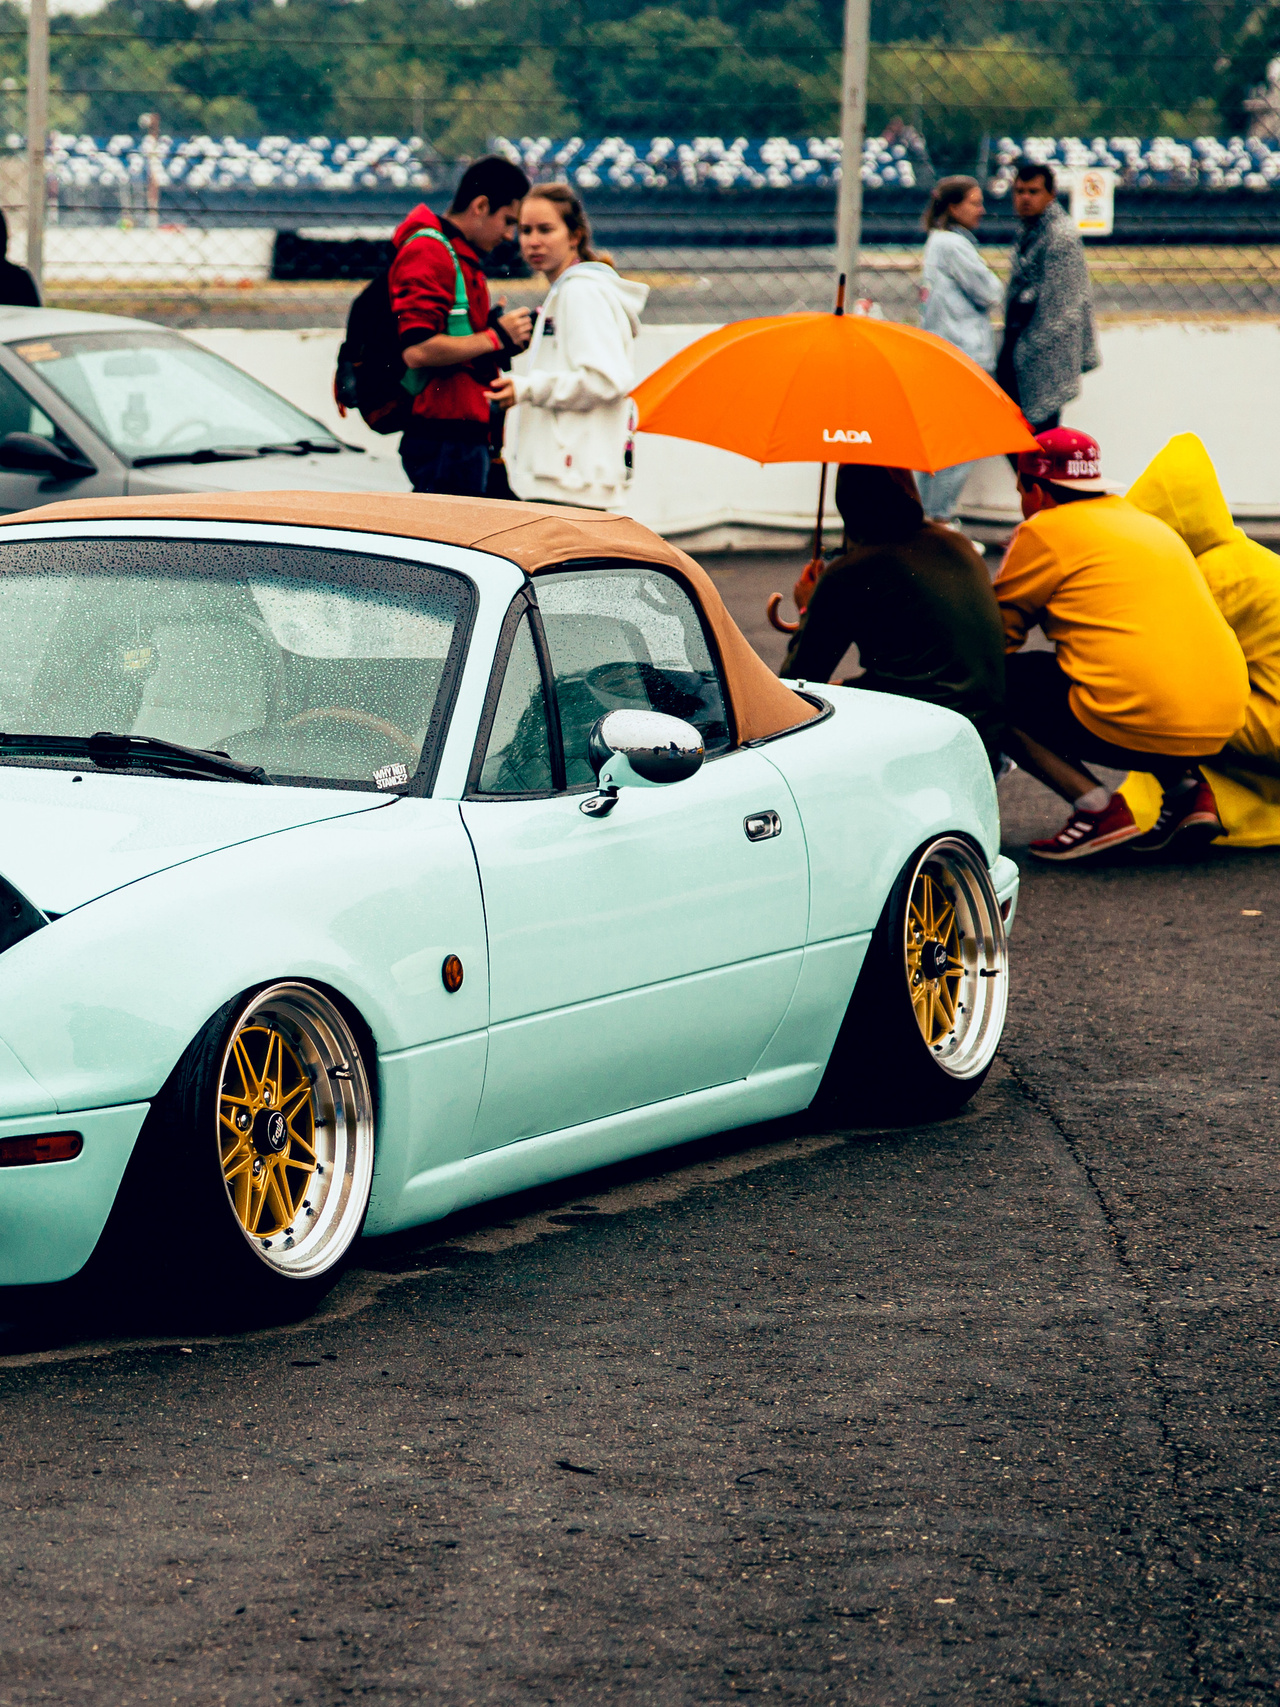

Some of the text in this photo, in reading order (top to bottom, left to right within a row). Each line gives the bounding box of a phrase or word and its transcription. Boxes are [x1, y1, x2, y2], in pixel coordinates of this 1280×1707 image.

[823, 428, 873, 444] LADA
[372, 767, 391, 780] WHY
[391, 764, 407, 776] NOT
[376, 774, 408, 789] STANCE?
